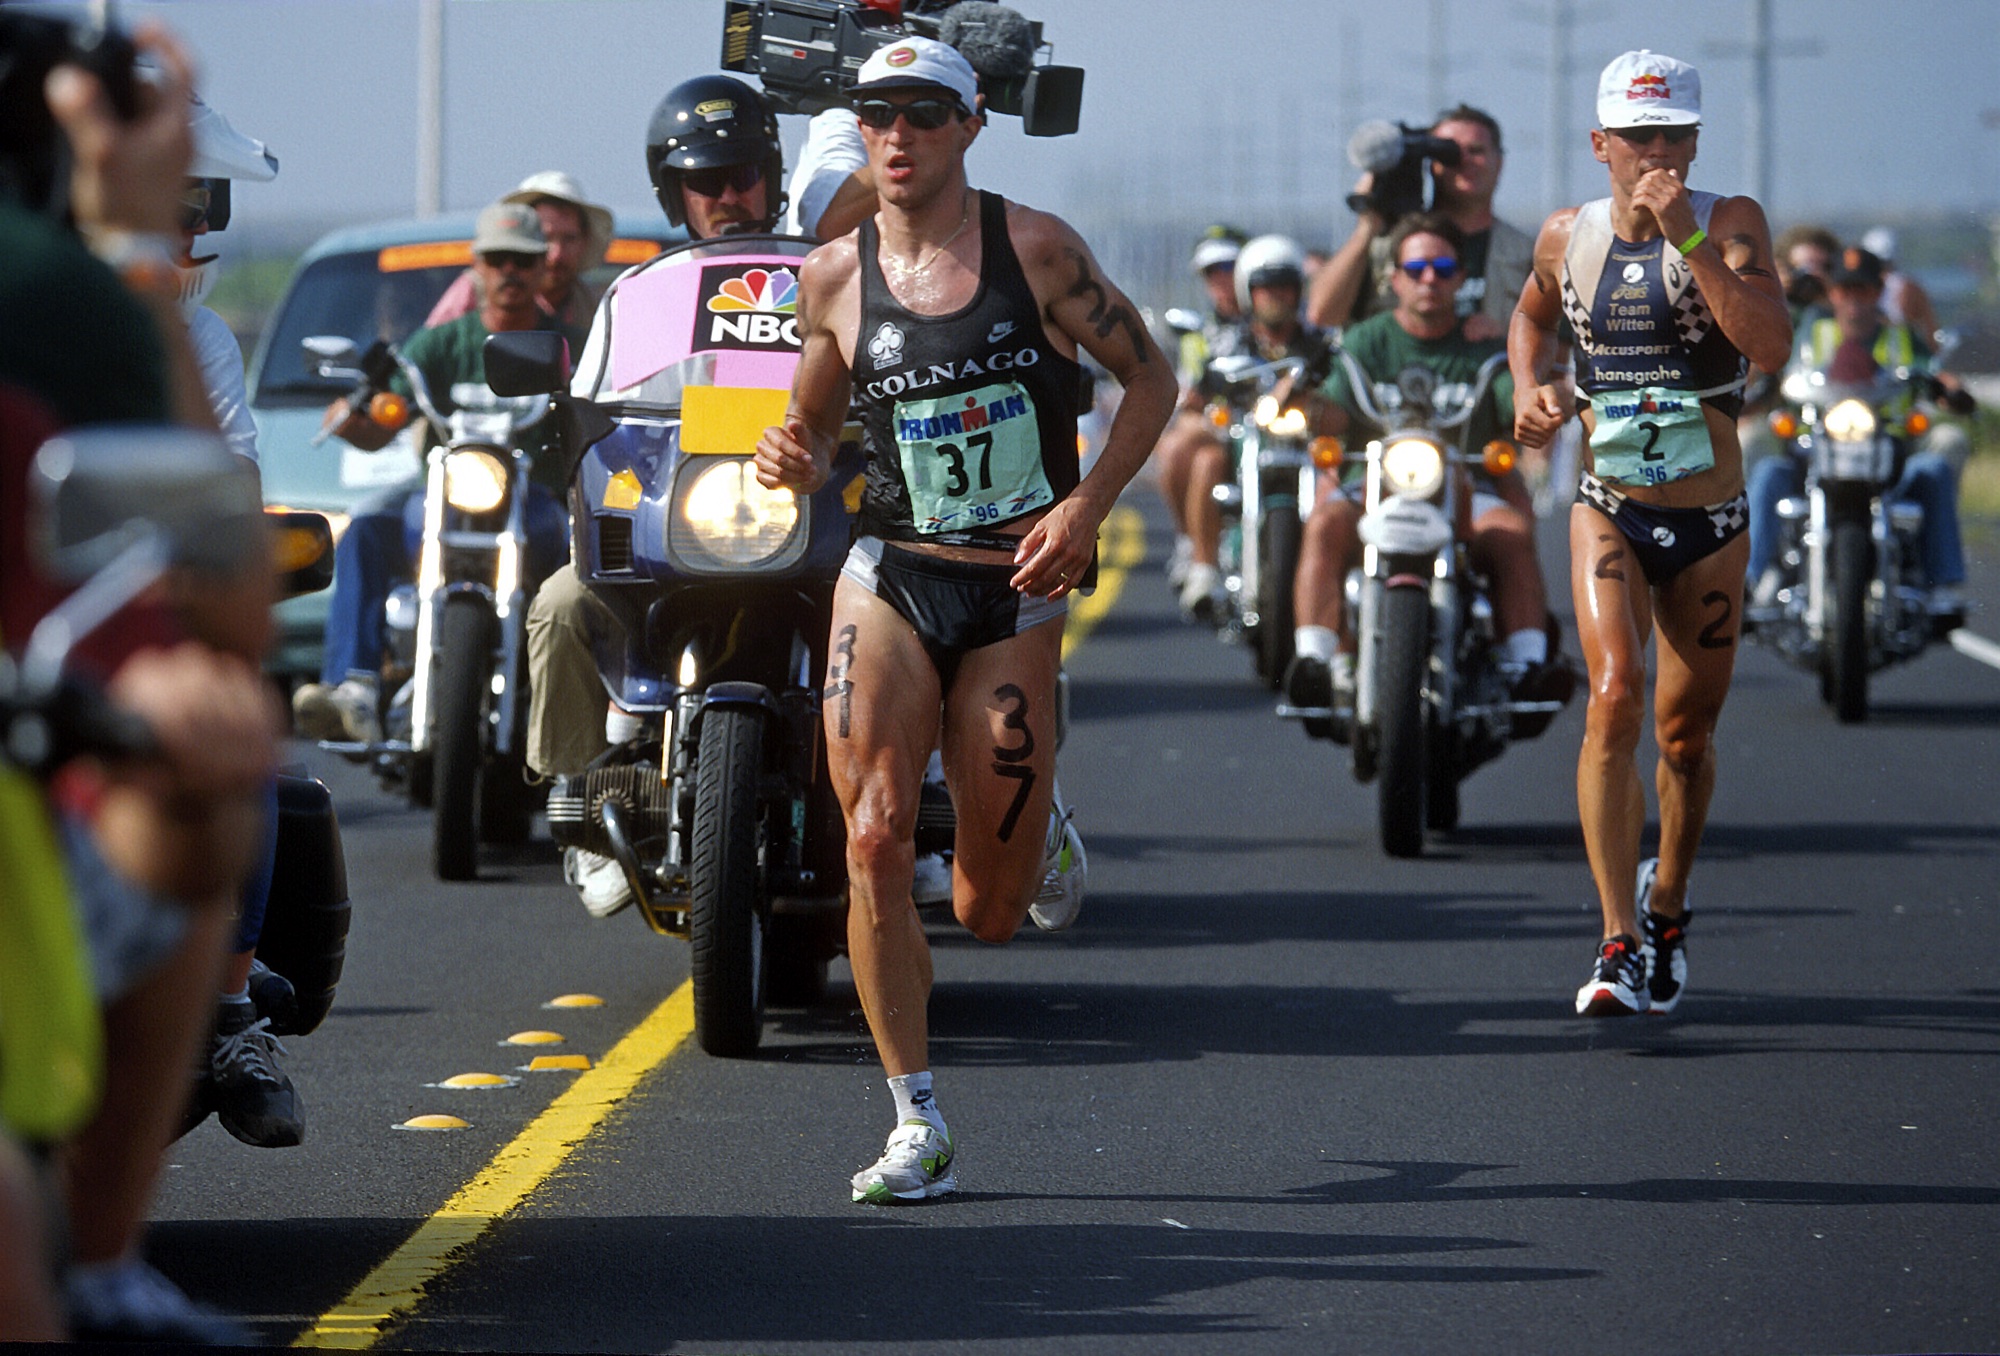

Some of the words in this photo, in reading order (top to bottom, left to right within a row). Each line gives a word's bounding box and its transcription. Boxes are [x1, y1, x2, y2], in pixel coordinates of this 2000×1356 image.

[1061, 246, 1147, 363] 37
[1606, 320, 1656, 332] Witten
[1609, 304, 1651, 316] Team
[1593, 343, 1671, 356] ACCUSPORT
[867, 348, 1040, 399] COLNAGO
[1594, 365, 1682, 385] hansgrohe
[899, 394, 1027, 441] IRONMAN
[1638, 421, 1665, 462] 2
[936, 431, 993, 497] 37
[1639, 465, 1667, 482] '96
[969, 502, 999, 523] '96
[1595, 534, 1625, 581] 2
[1697, 590, 1734, 648] 2
[991, 683, 1037, 843] 37
